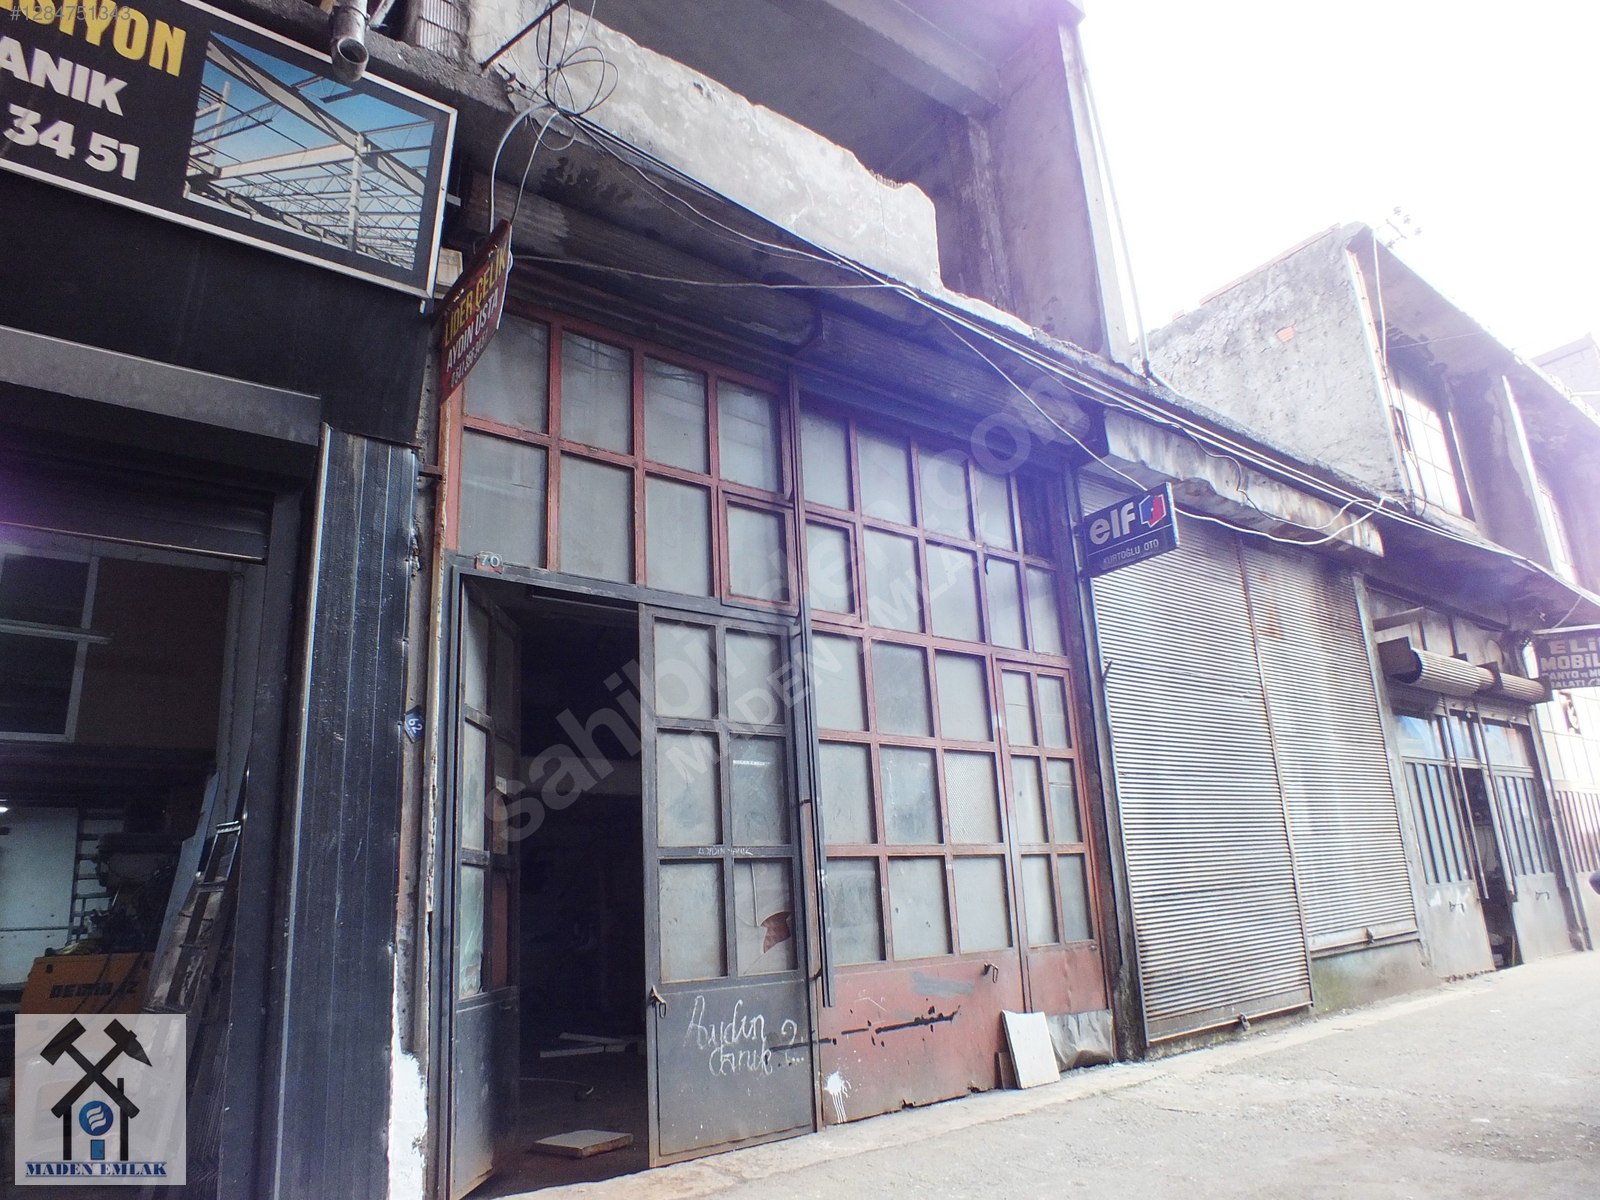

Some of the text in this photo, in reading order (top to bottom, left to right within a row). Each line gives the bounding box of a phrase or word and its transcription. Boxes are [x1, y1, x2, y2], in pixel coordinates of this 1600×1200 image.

[4, 103, 140, 181] 34 51
[446, 287, 499, 373] AYDIN USTA
[1089, 502, 1136, 545] elf
[1143, 538, 1160, 551] OTO
[481, 554, 500, 567] 70
[408, 718, 423, 734] 62
